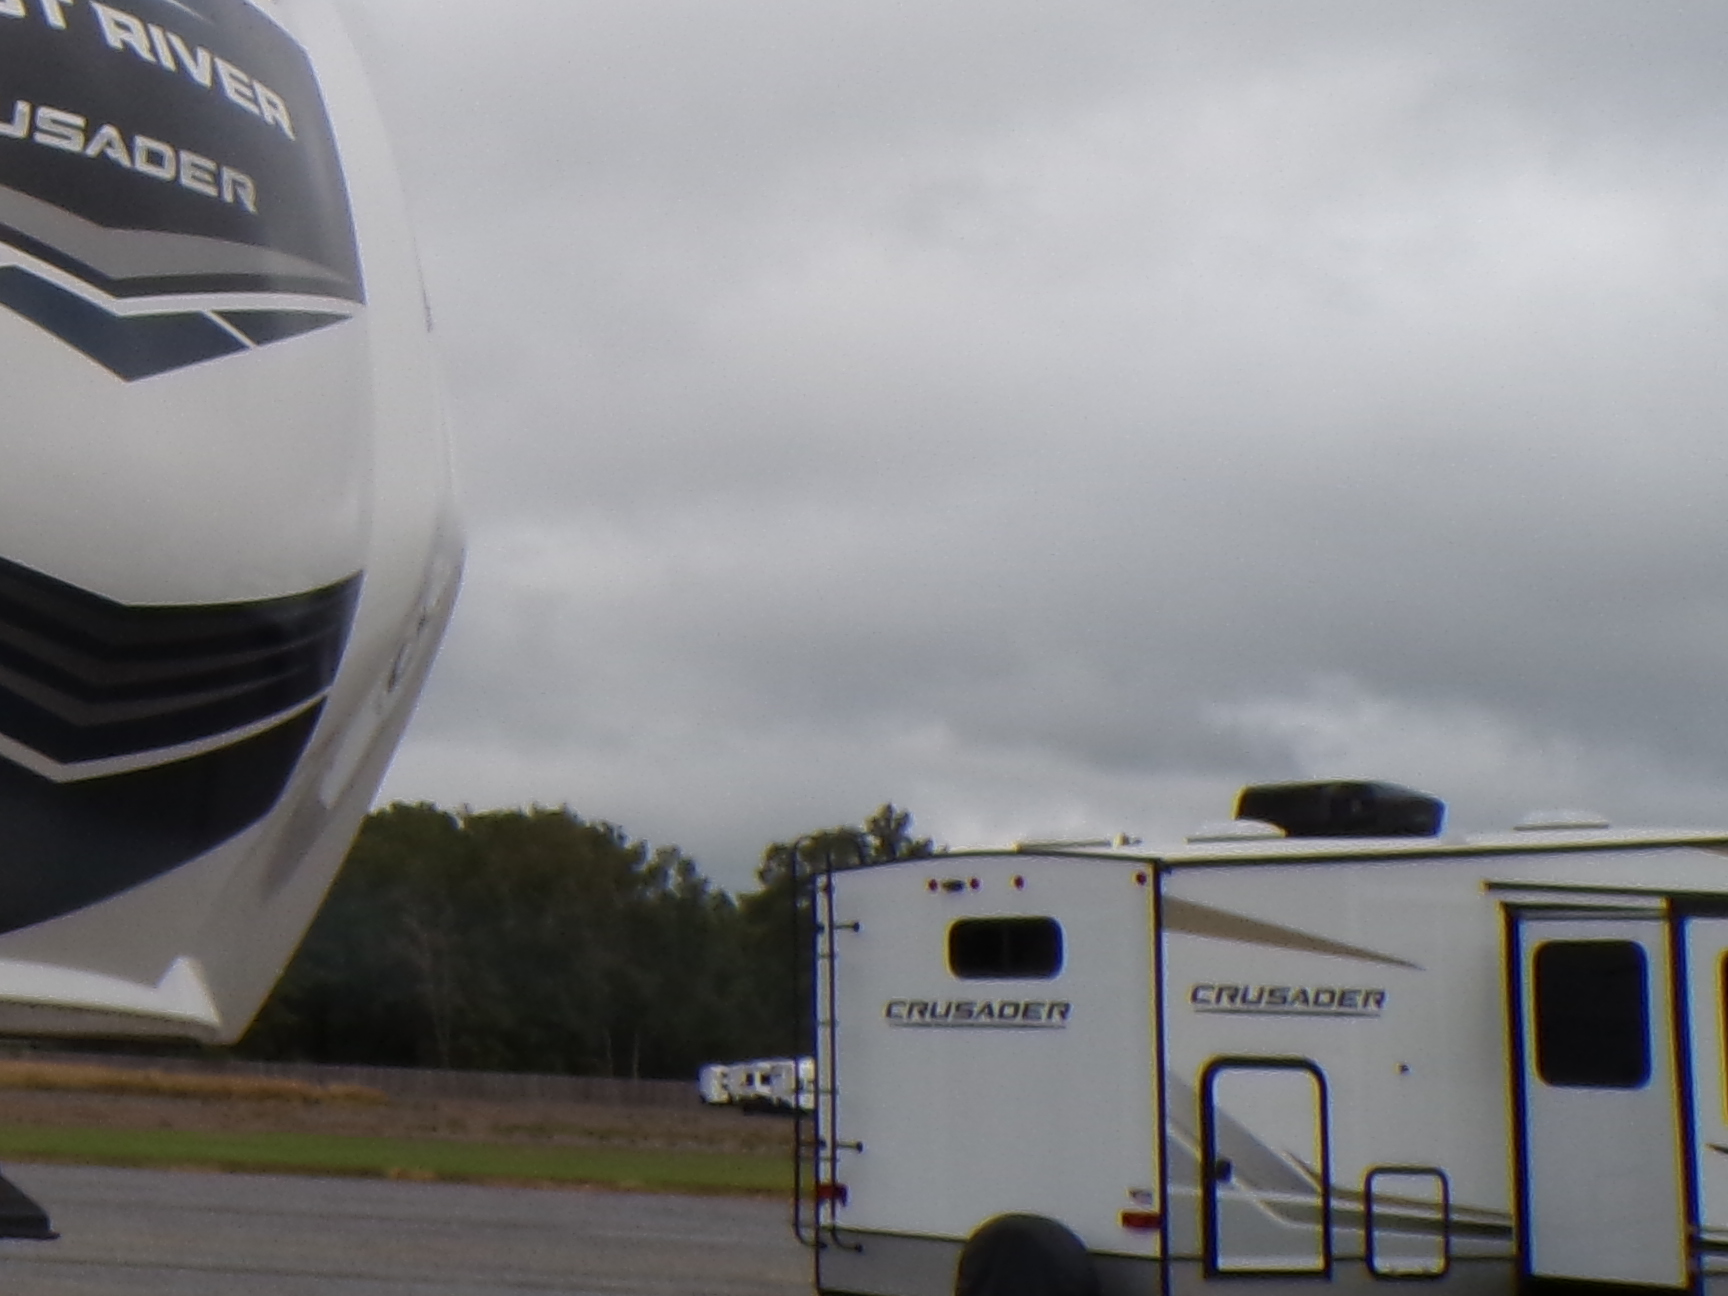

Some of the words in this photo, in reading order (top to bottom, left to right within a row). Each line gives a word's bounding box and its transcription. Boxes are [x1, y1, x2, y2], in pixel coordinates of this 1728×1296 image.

[91, 1, 297, 140] RIVER
[1190, 983, 1386, 1010] CRUSADER
[884, 999, 1072, 1023] CRUSADER
